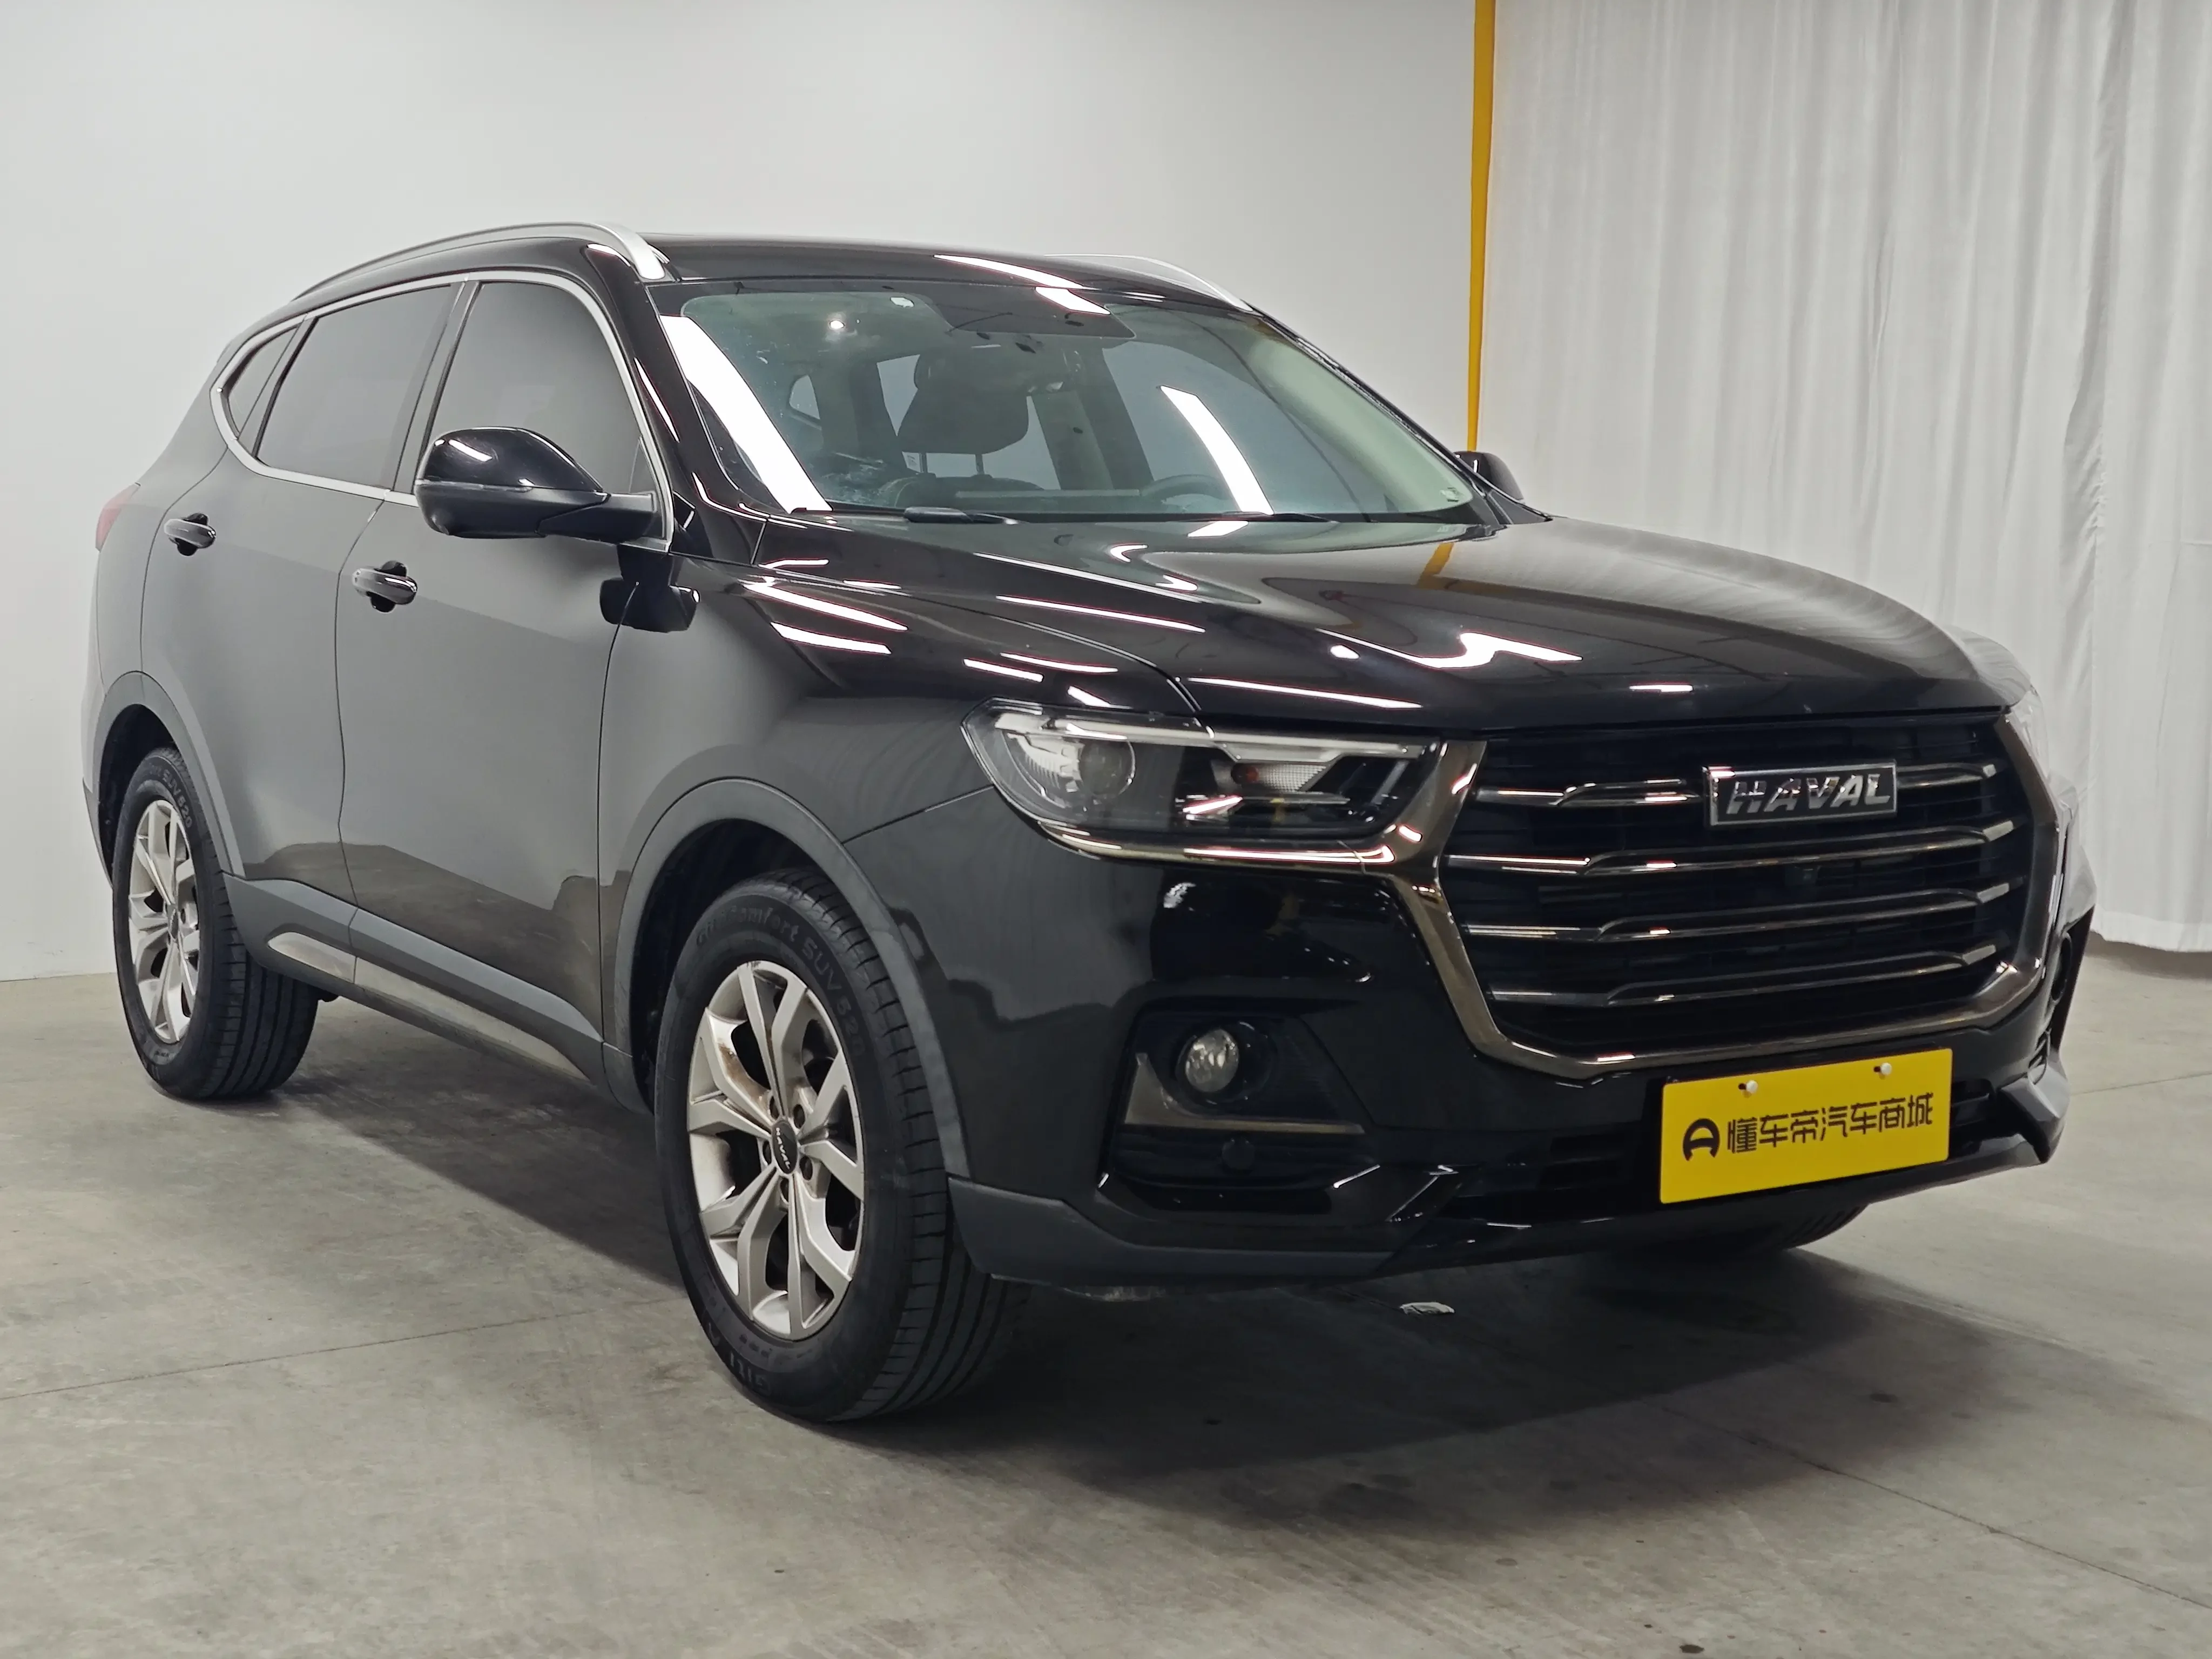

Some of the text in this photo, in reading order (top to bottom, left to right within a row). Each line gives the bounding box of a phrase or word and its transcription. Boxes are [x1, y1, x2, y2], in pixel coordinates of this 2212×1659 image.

[1726, 773, 1891, 814] HAVAL
[801, 941, 841, 990] SUV
[837, 1000, 865, 1056] 520
[1727, 1092, 1934, 1154] 懂车帝汽车商城
